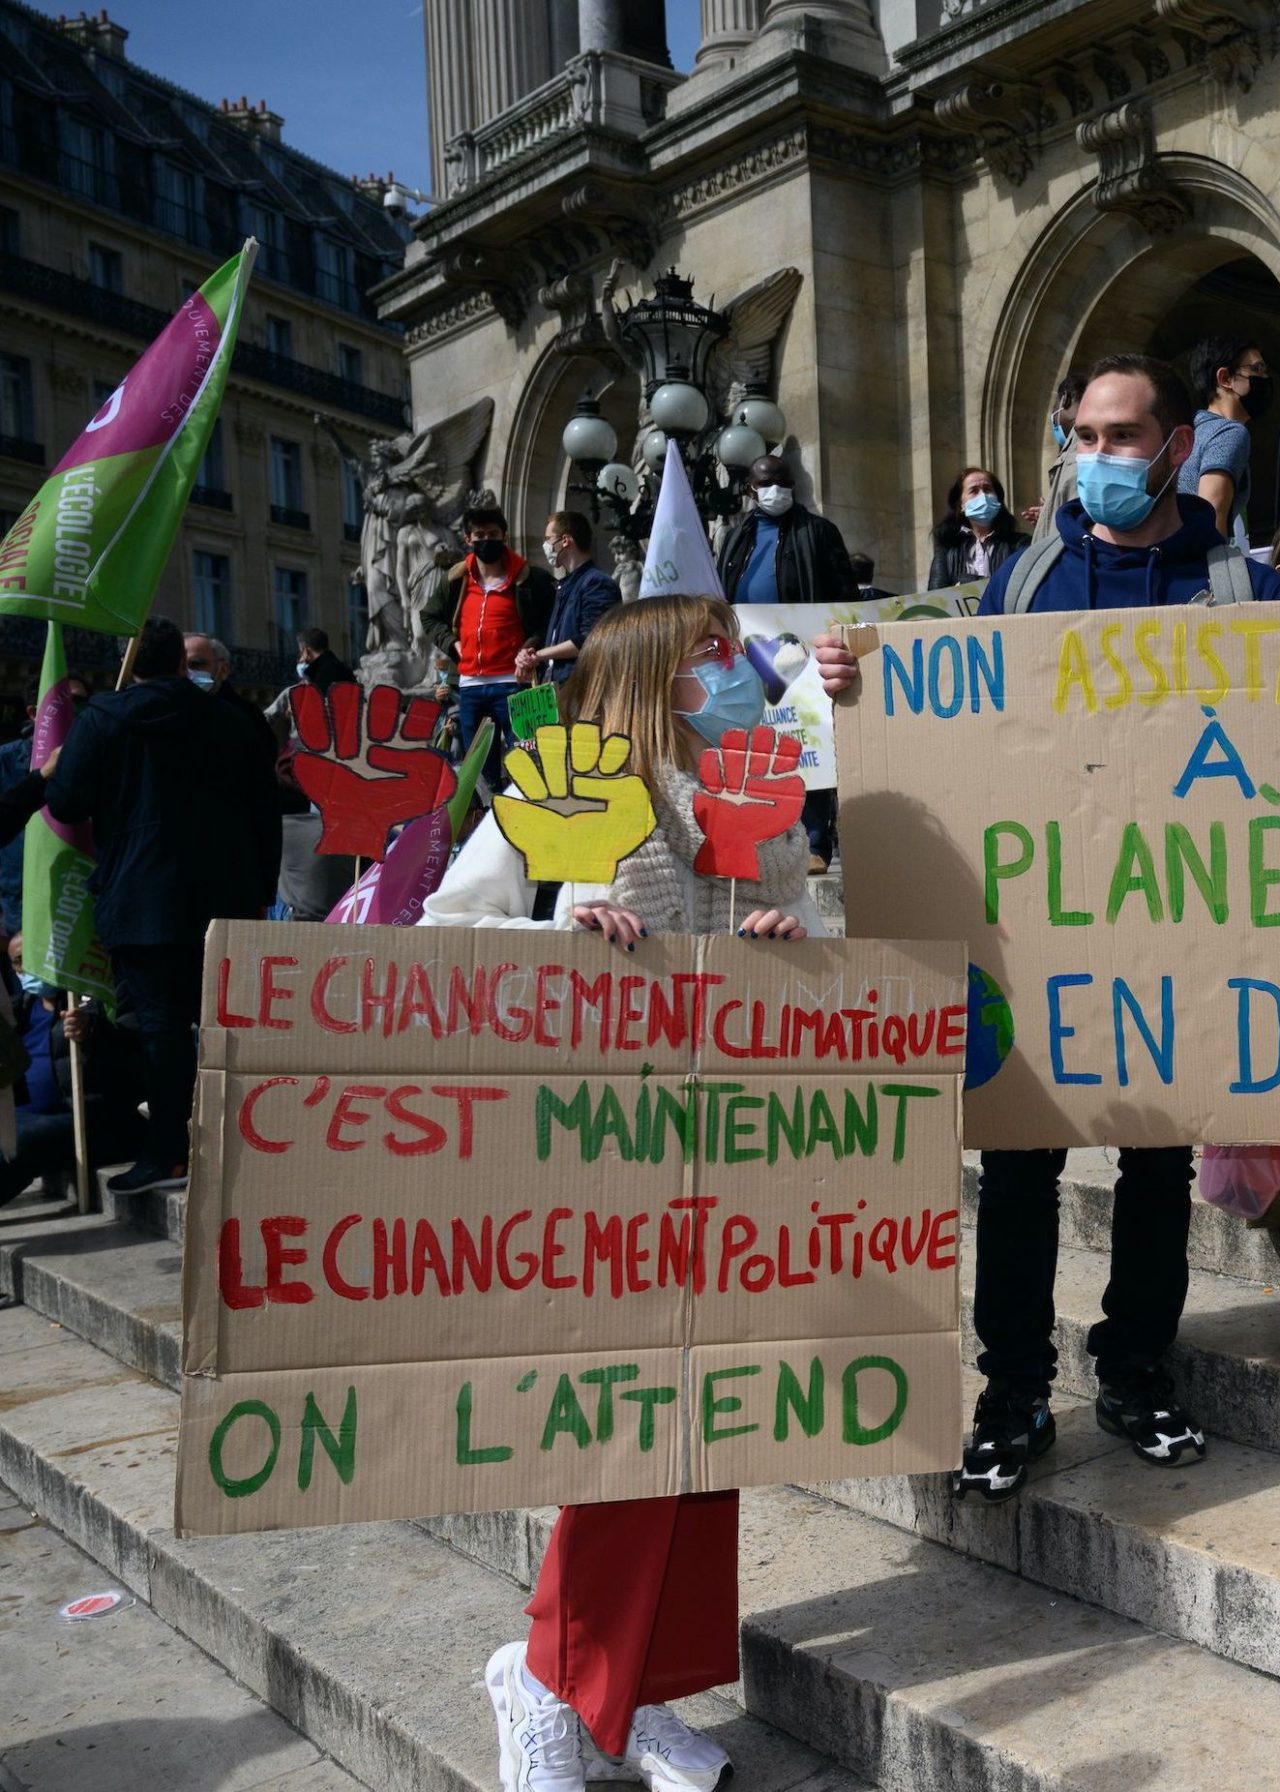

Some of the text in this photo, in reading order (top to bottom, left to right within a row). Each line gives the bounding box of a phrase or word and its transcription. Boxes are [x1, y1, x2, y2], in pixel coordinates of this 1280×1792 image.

[161, 393, 191, 423] DES
[53, 467, 102, 600] L'ÉCOLOGIE
[883, 630, 1004, 719] NON
[1173, 705, 1256, 798] À
[218, 956, 298, 1031] LE
[311, 956, 726, 1053] CHANGEMENT
[1047, 973, 1174, 1087] EN
[239, 1063, 942, 1165] C'EST MAINTENANT
[219, 1216, 315, 1309] LE
[322, 1197, 719, 1302] CHANGEMENT
[209, 1355, 908, 1498] ON L'ATTEND
